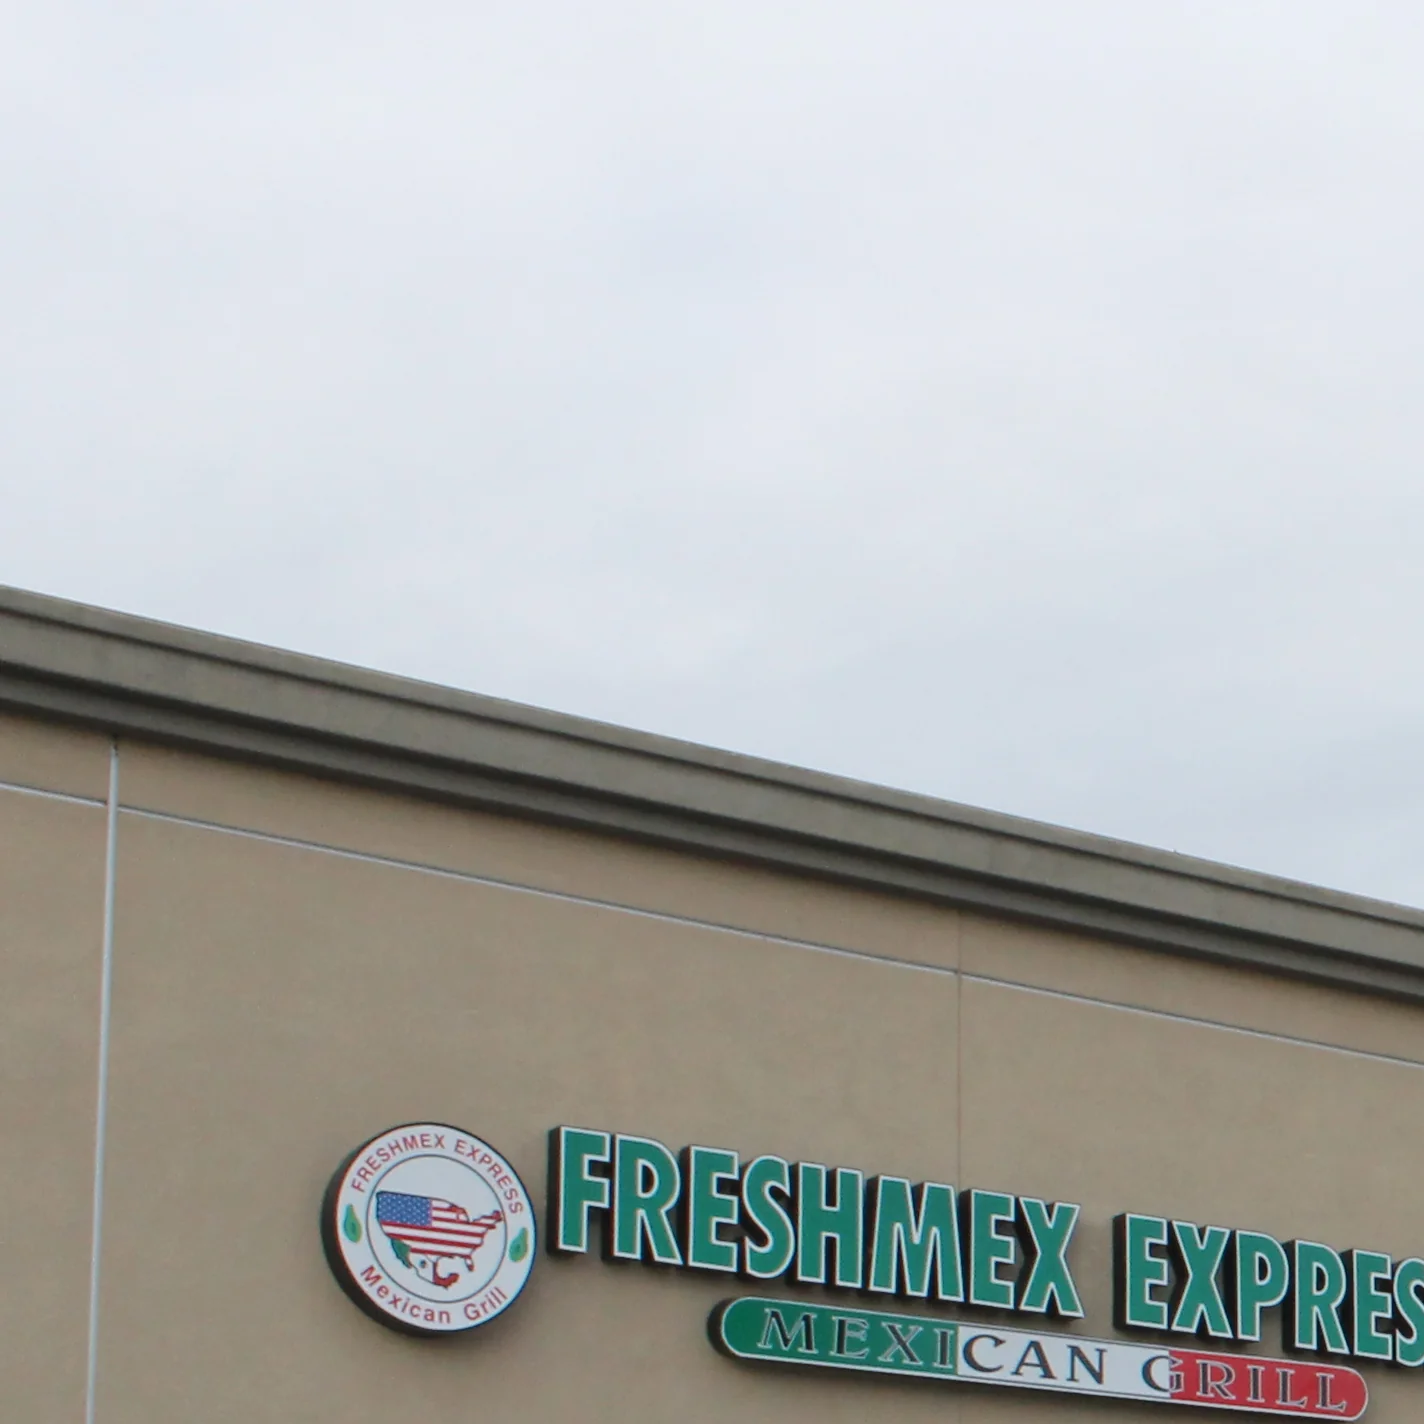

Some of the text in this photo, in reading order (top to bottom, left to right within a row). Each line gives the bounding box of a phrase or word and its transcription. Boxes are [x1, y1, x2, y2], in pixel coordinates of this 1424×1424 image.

[351, 1133, 523, 1214] FRESHMEX EXPRESS
[552, 1126, 1084, 1318] FRESHMEX
[361, 1265, 508, 1324] Mexican Grill
[757, 1308, 1348, 1413] MEXICAN GRILL
